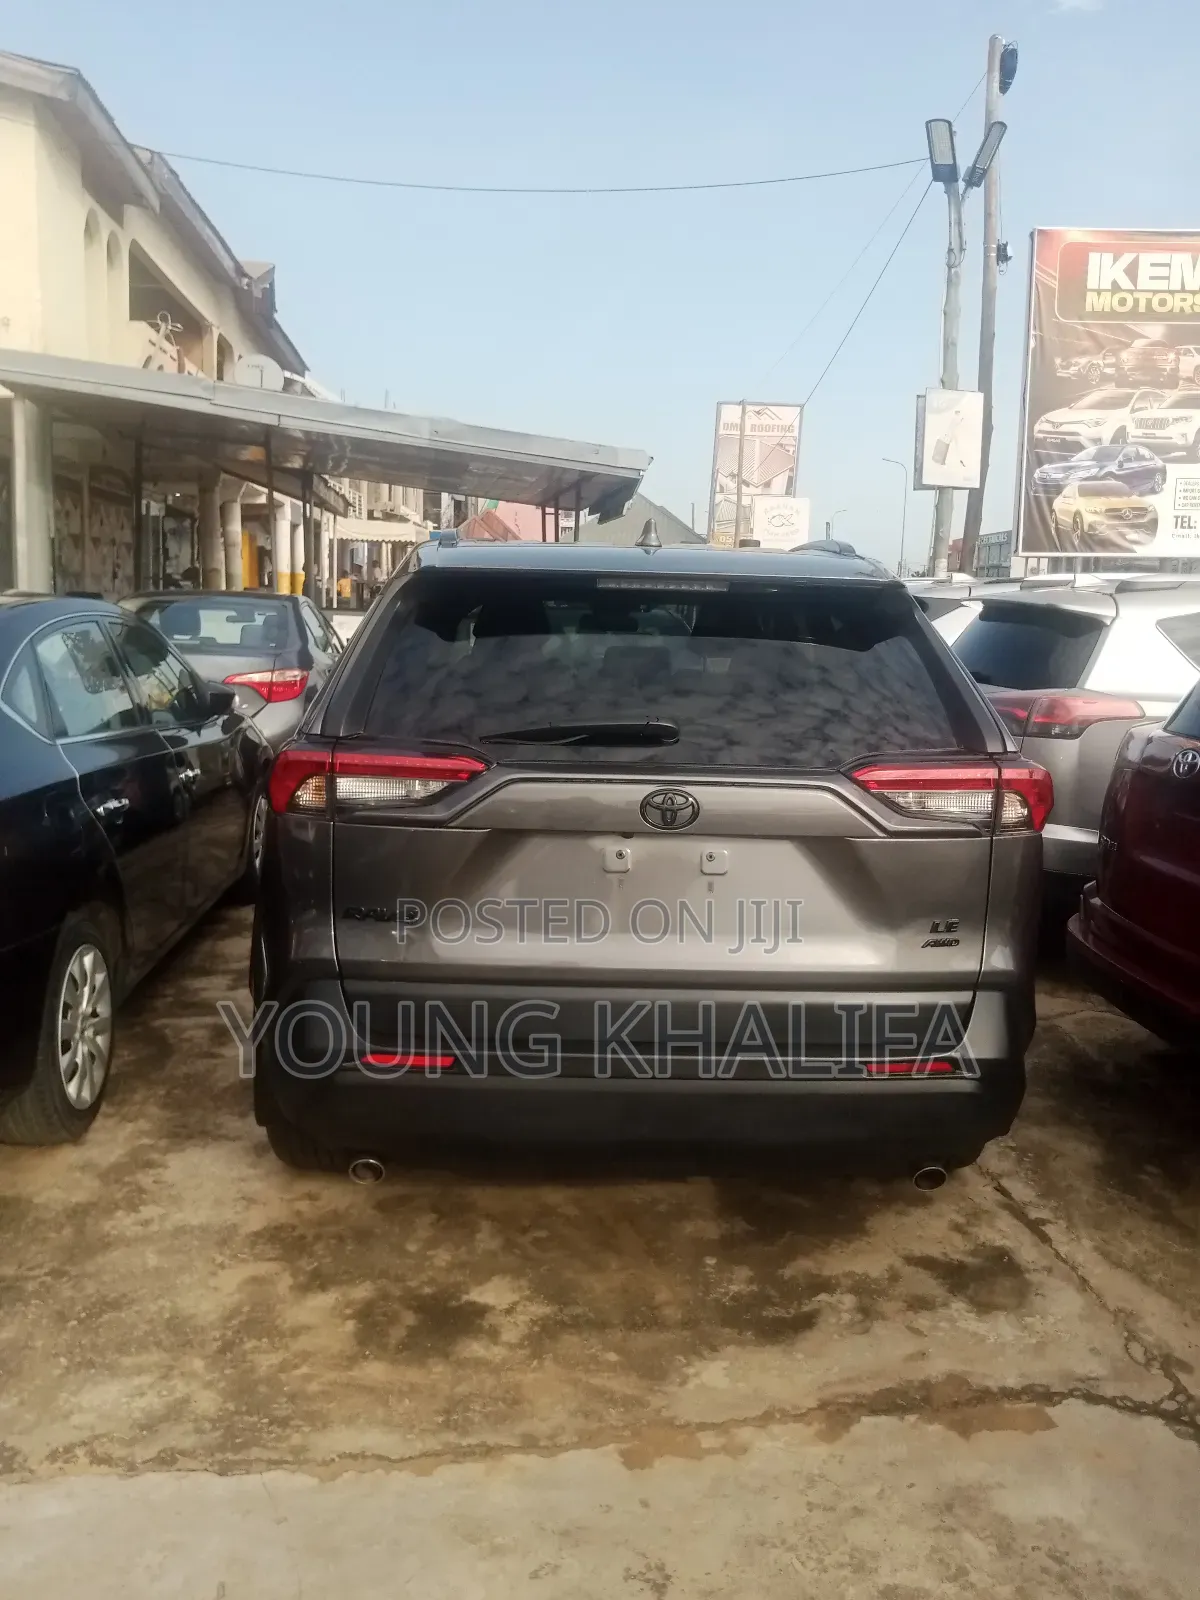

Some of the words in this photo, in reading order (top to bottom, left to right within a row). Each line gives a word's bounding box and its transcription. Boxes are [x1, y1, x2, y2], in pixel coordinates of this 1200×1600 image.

[750, 423, 795, 434] ROOFING
[1173, 515, 1197, 529] TEL:
[930, 918, 960, 933] LE
